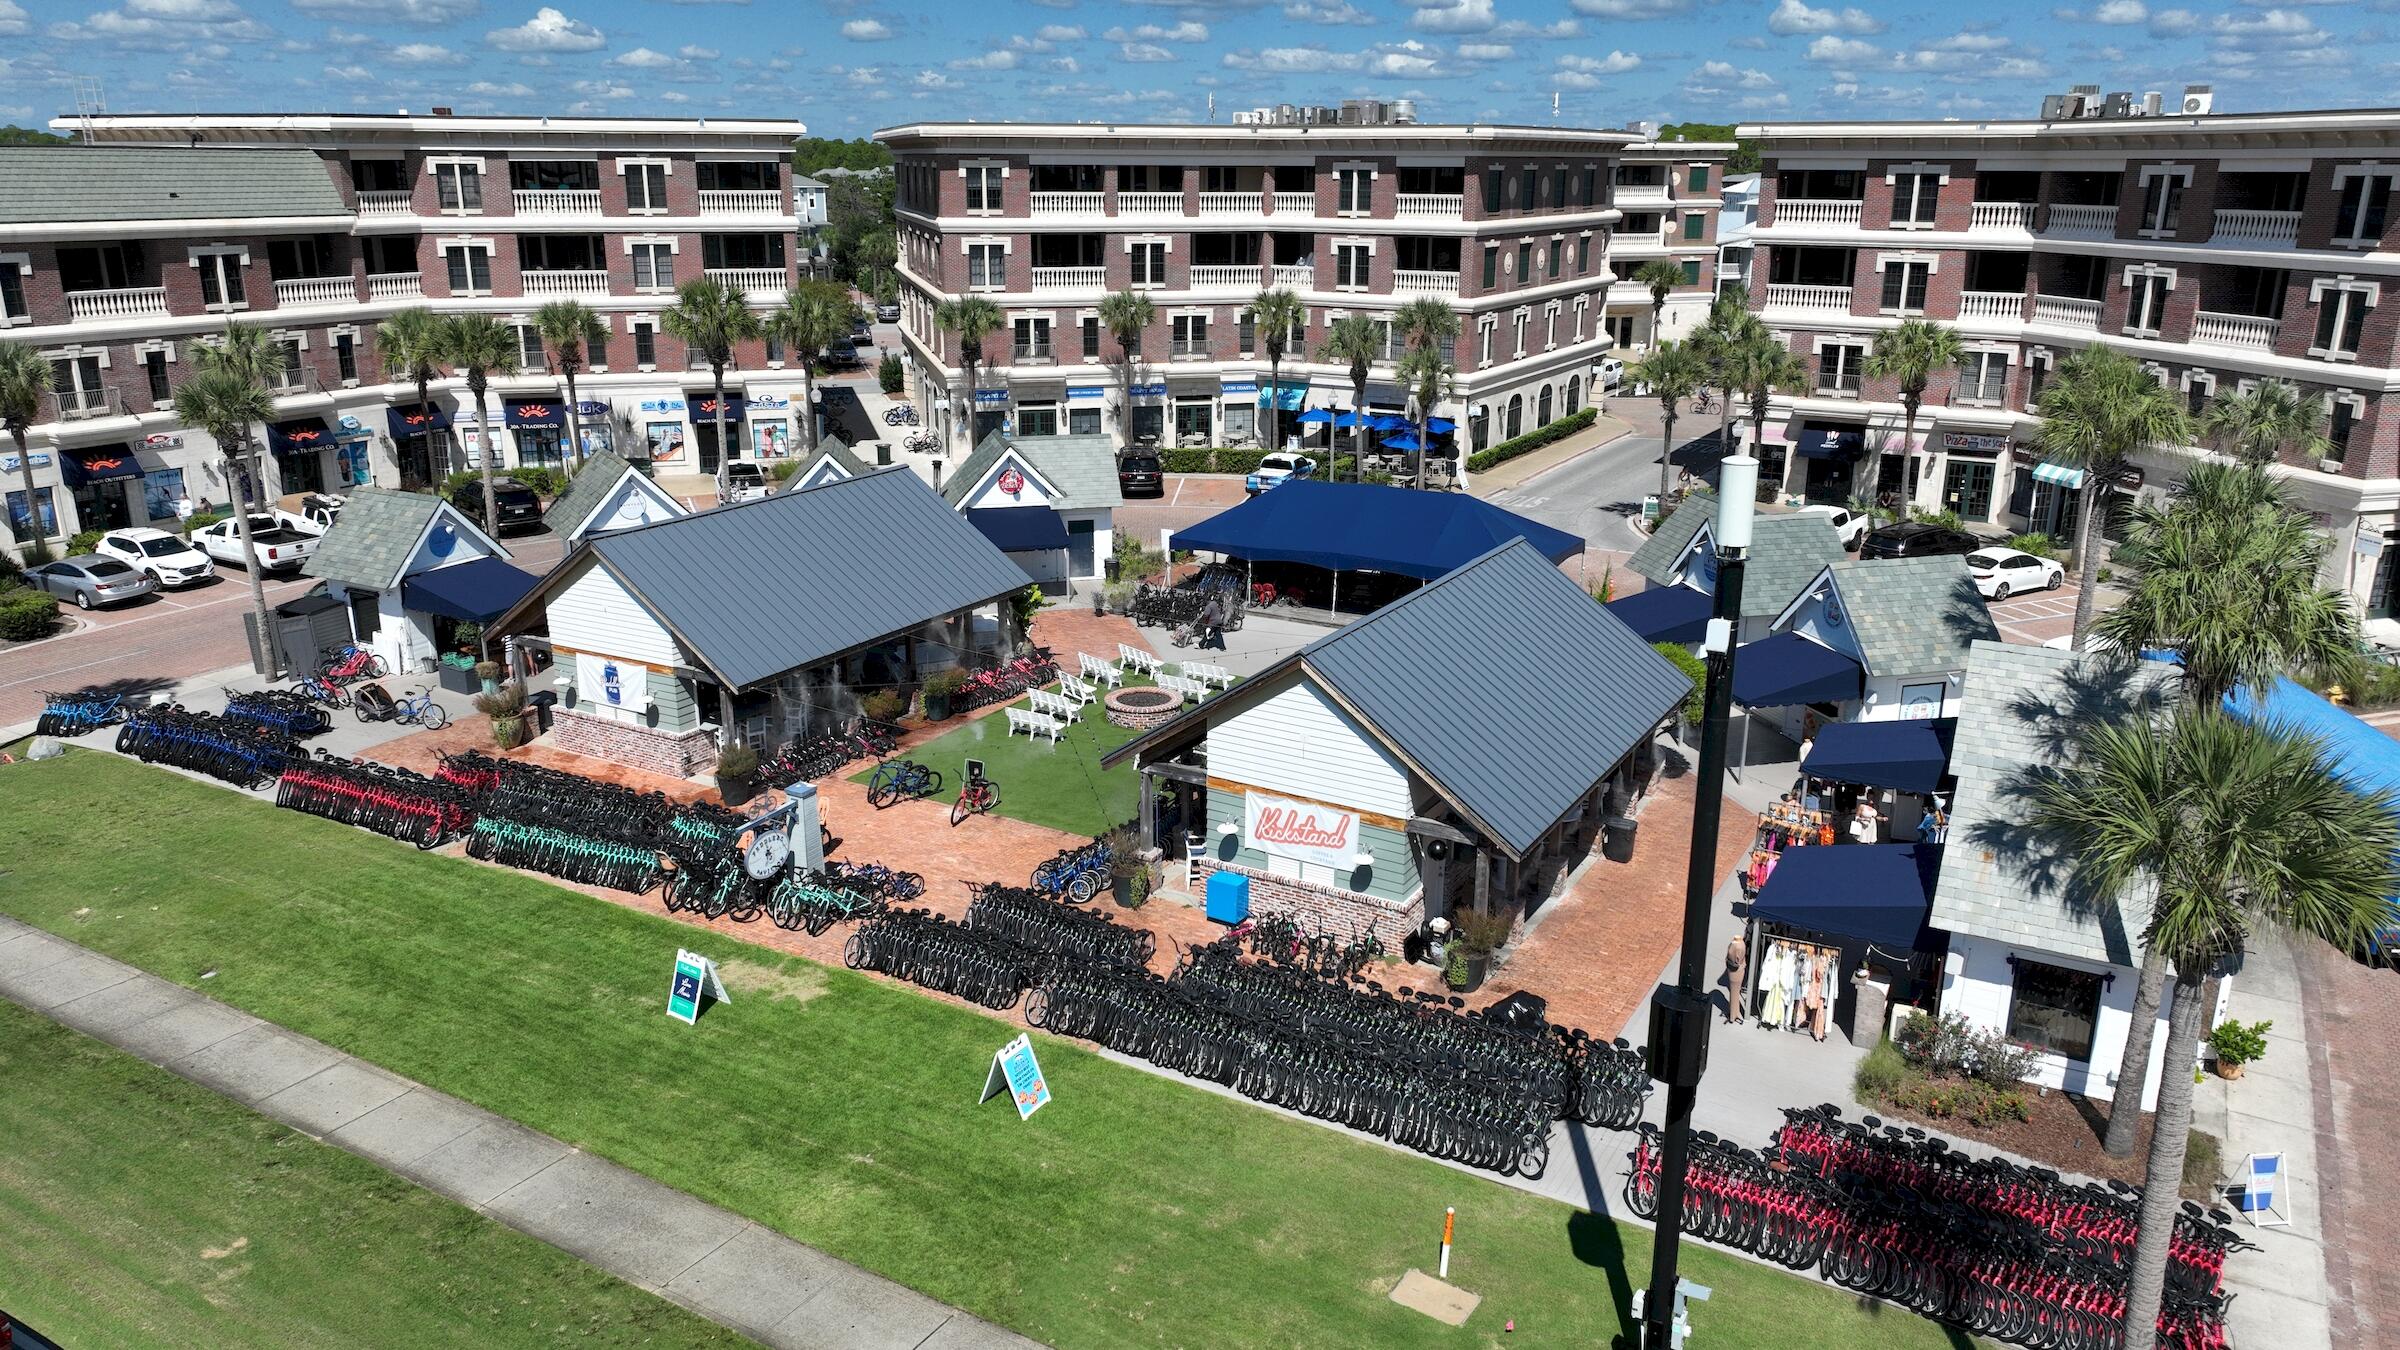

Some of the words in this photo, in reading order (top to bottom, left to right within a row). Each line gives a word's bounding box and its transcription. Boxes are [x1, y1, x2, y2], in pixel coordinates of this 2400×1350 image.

[1945, 434, 1968, 447] Pizza
[105, 474, 136, 483] OUTFITTERS
[1255, 806, 1350, 849] Kickstand
